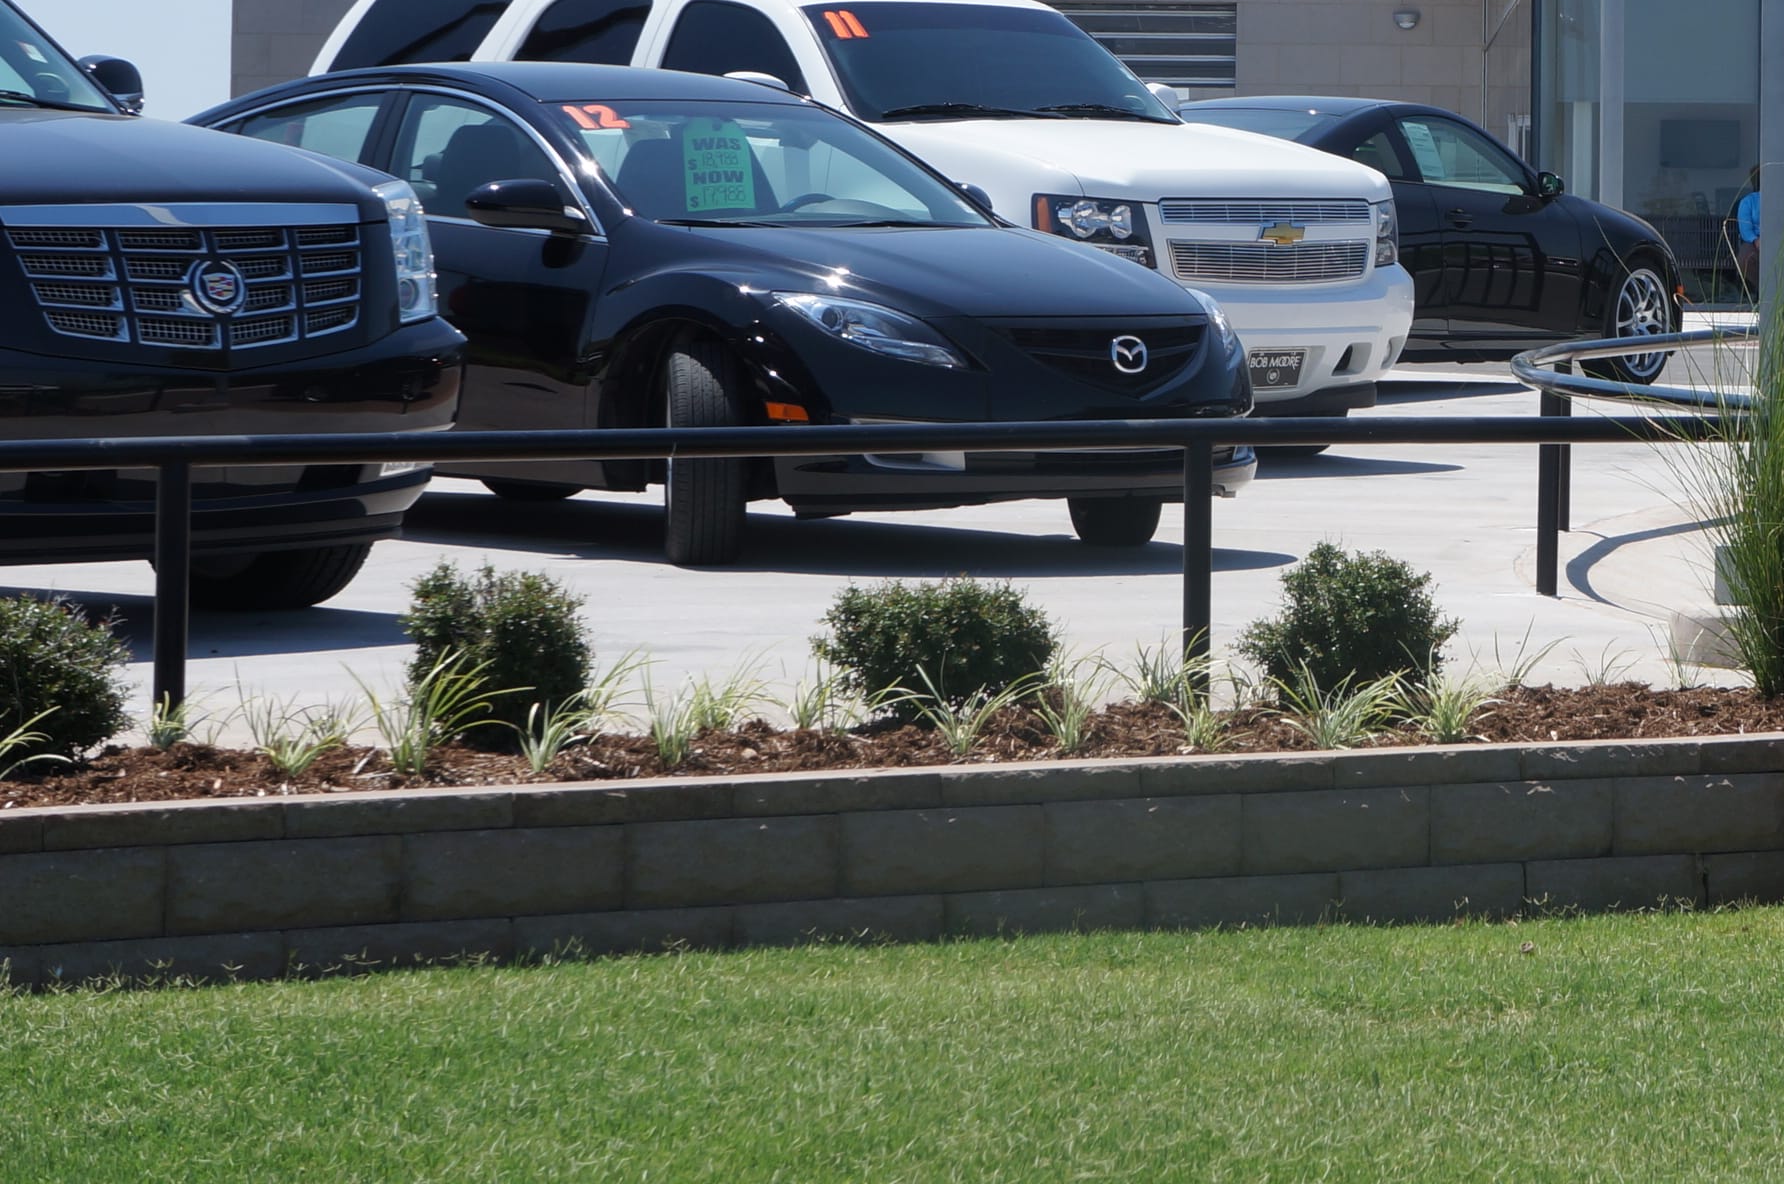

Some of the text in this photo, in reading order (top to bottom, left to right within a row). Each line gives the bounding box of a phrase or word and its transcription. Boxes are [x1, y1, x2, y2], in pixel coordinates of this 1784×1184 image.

[822, 10, 870, 39] 11
[561, 104, 631, 130] 12
[692, 137, 742, 152] WAS
[692, 170, 745, 185] NOW
[1249, 355, 1302, 371] BOB MOORE
